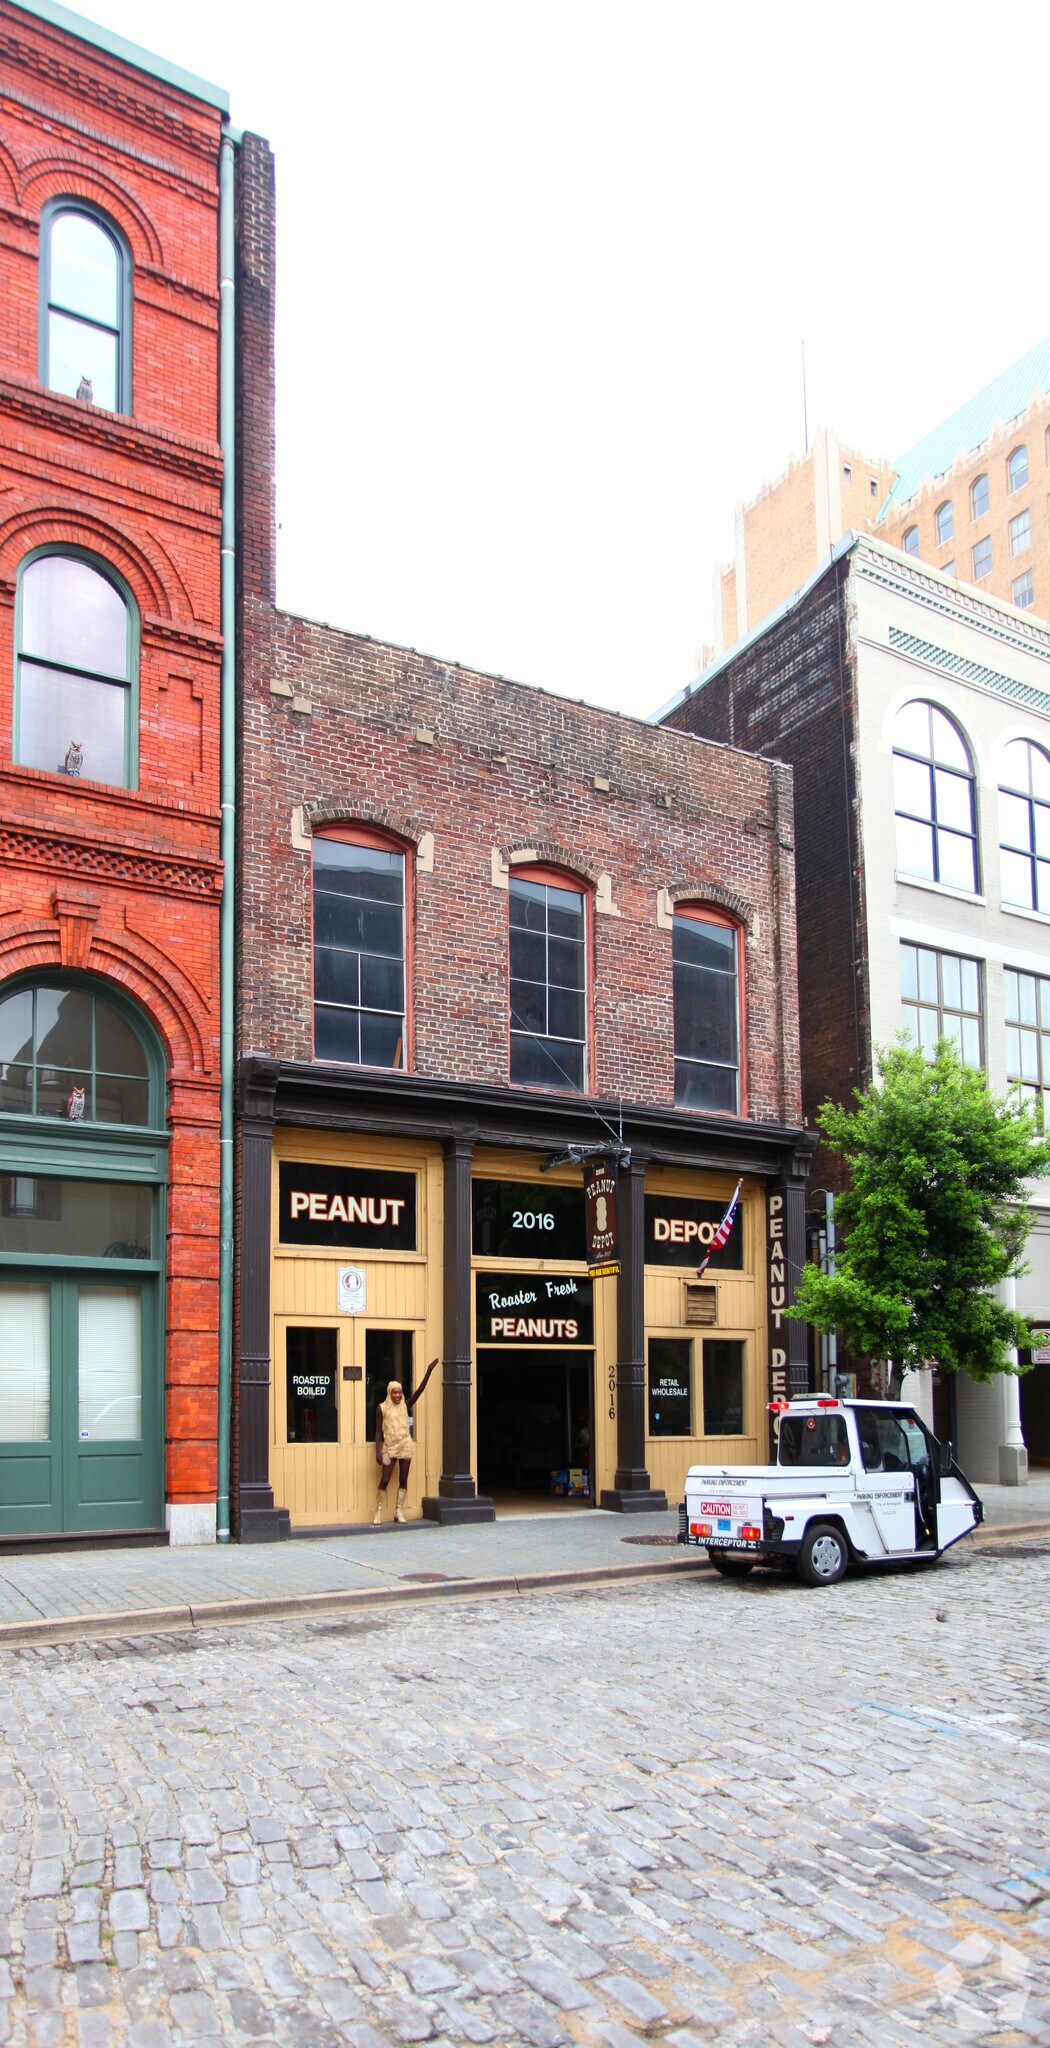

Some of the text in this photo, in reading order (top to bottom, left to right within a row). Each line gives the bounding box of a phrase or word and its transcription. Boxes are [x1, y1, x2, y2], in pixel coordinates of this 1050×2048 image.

[586, 1179, 616, 1200] PEANUT
[290, 1191, 404, 1225] PEANUT
[511, 1211, 556, 1231] 2016
[591, 1231, 614, 1249] DEPOT
[769, 1196, 786, 1329] PEANUT
[488, 1278, 579, 1310] Roaster Fresh
[490, 1317, 579, 1339] PEANUTS
[292, 1375, 331, 1385] ROASTED
[659, 1378, 680, 1387] RETAIL
[297, 1386, 327, 1396] BOILED
[608, 1365, 616, 1420] 2016
[651, 1387, 688, 1396] WHOLESALE
[718, 1479, 748, 1487] ENFORCEMENT
[874, 1491, 903, 1500] ENFORCEMENT
[701, 1503, 731, 1515] CAUTION
[698, 1537, 747, 1548] INTERCEPTOR
